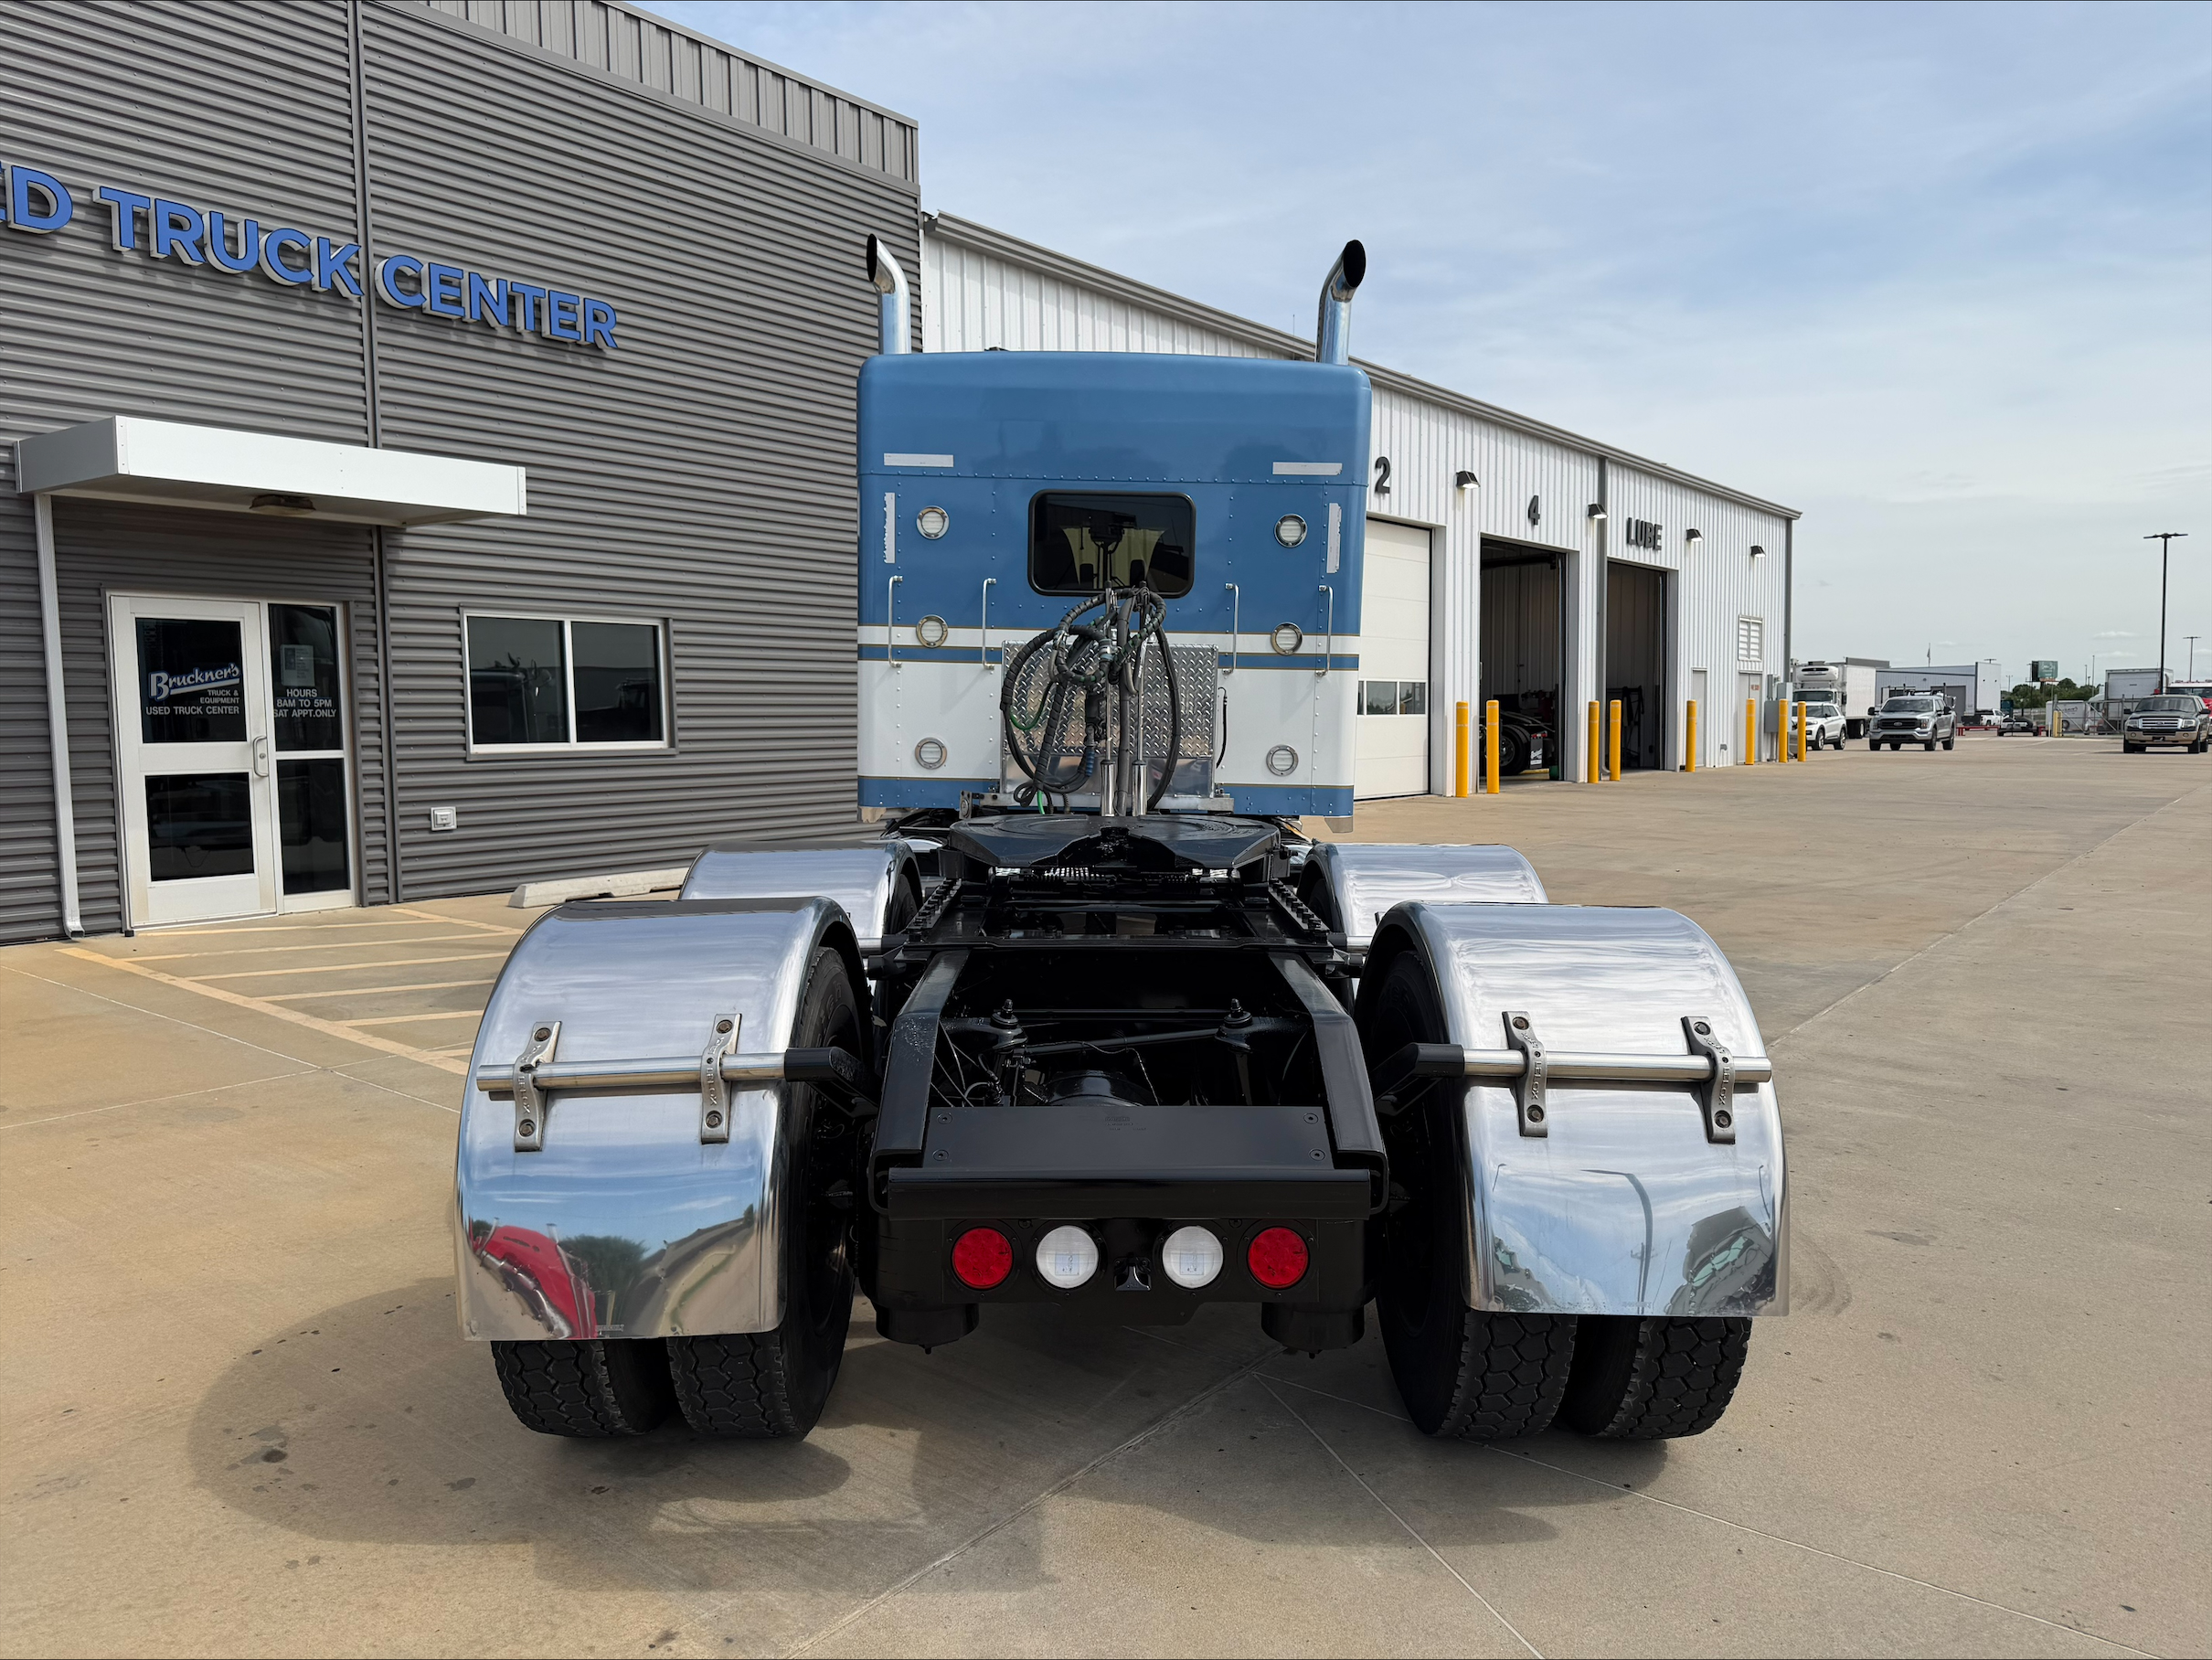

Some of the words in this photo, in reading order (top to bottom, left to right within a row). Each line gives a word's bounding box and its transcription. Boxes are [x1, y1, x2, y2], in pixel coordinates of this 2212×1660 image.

[0, 161, 73, 234] D
[93, 186, 364, 298] TRUCK
[375, 254, 618, 349] CENTER
[1374, 456, 1391, 495] 2
[1527, 495, 1541, 526] 4
[1626, 516, 1663, 551] LUBE
[149, 663, 239, 700] Bruckner's
[286, 688, 318, 697] HOURS
[145, 706, 171, 716] USED
[173, 706, 203, 715] TRUCK
[206, 706, 240, 715] CENTER
[273, 708, 289, 718] SAT
[276, 698, 296, 708] 8AM
[298, 698, 311, 708] TO
[314, 698, 333, 708] 5PM
